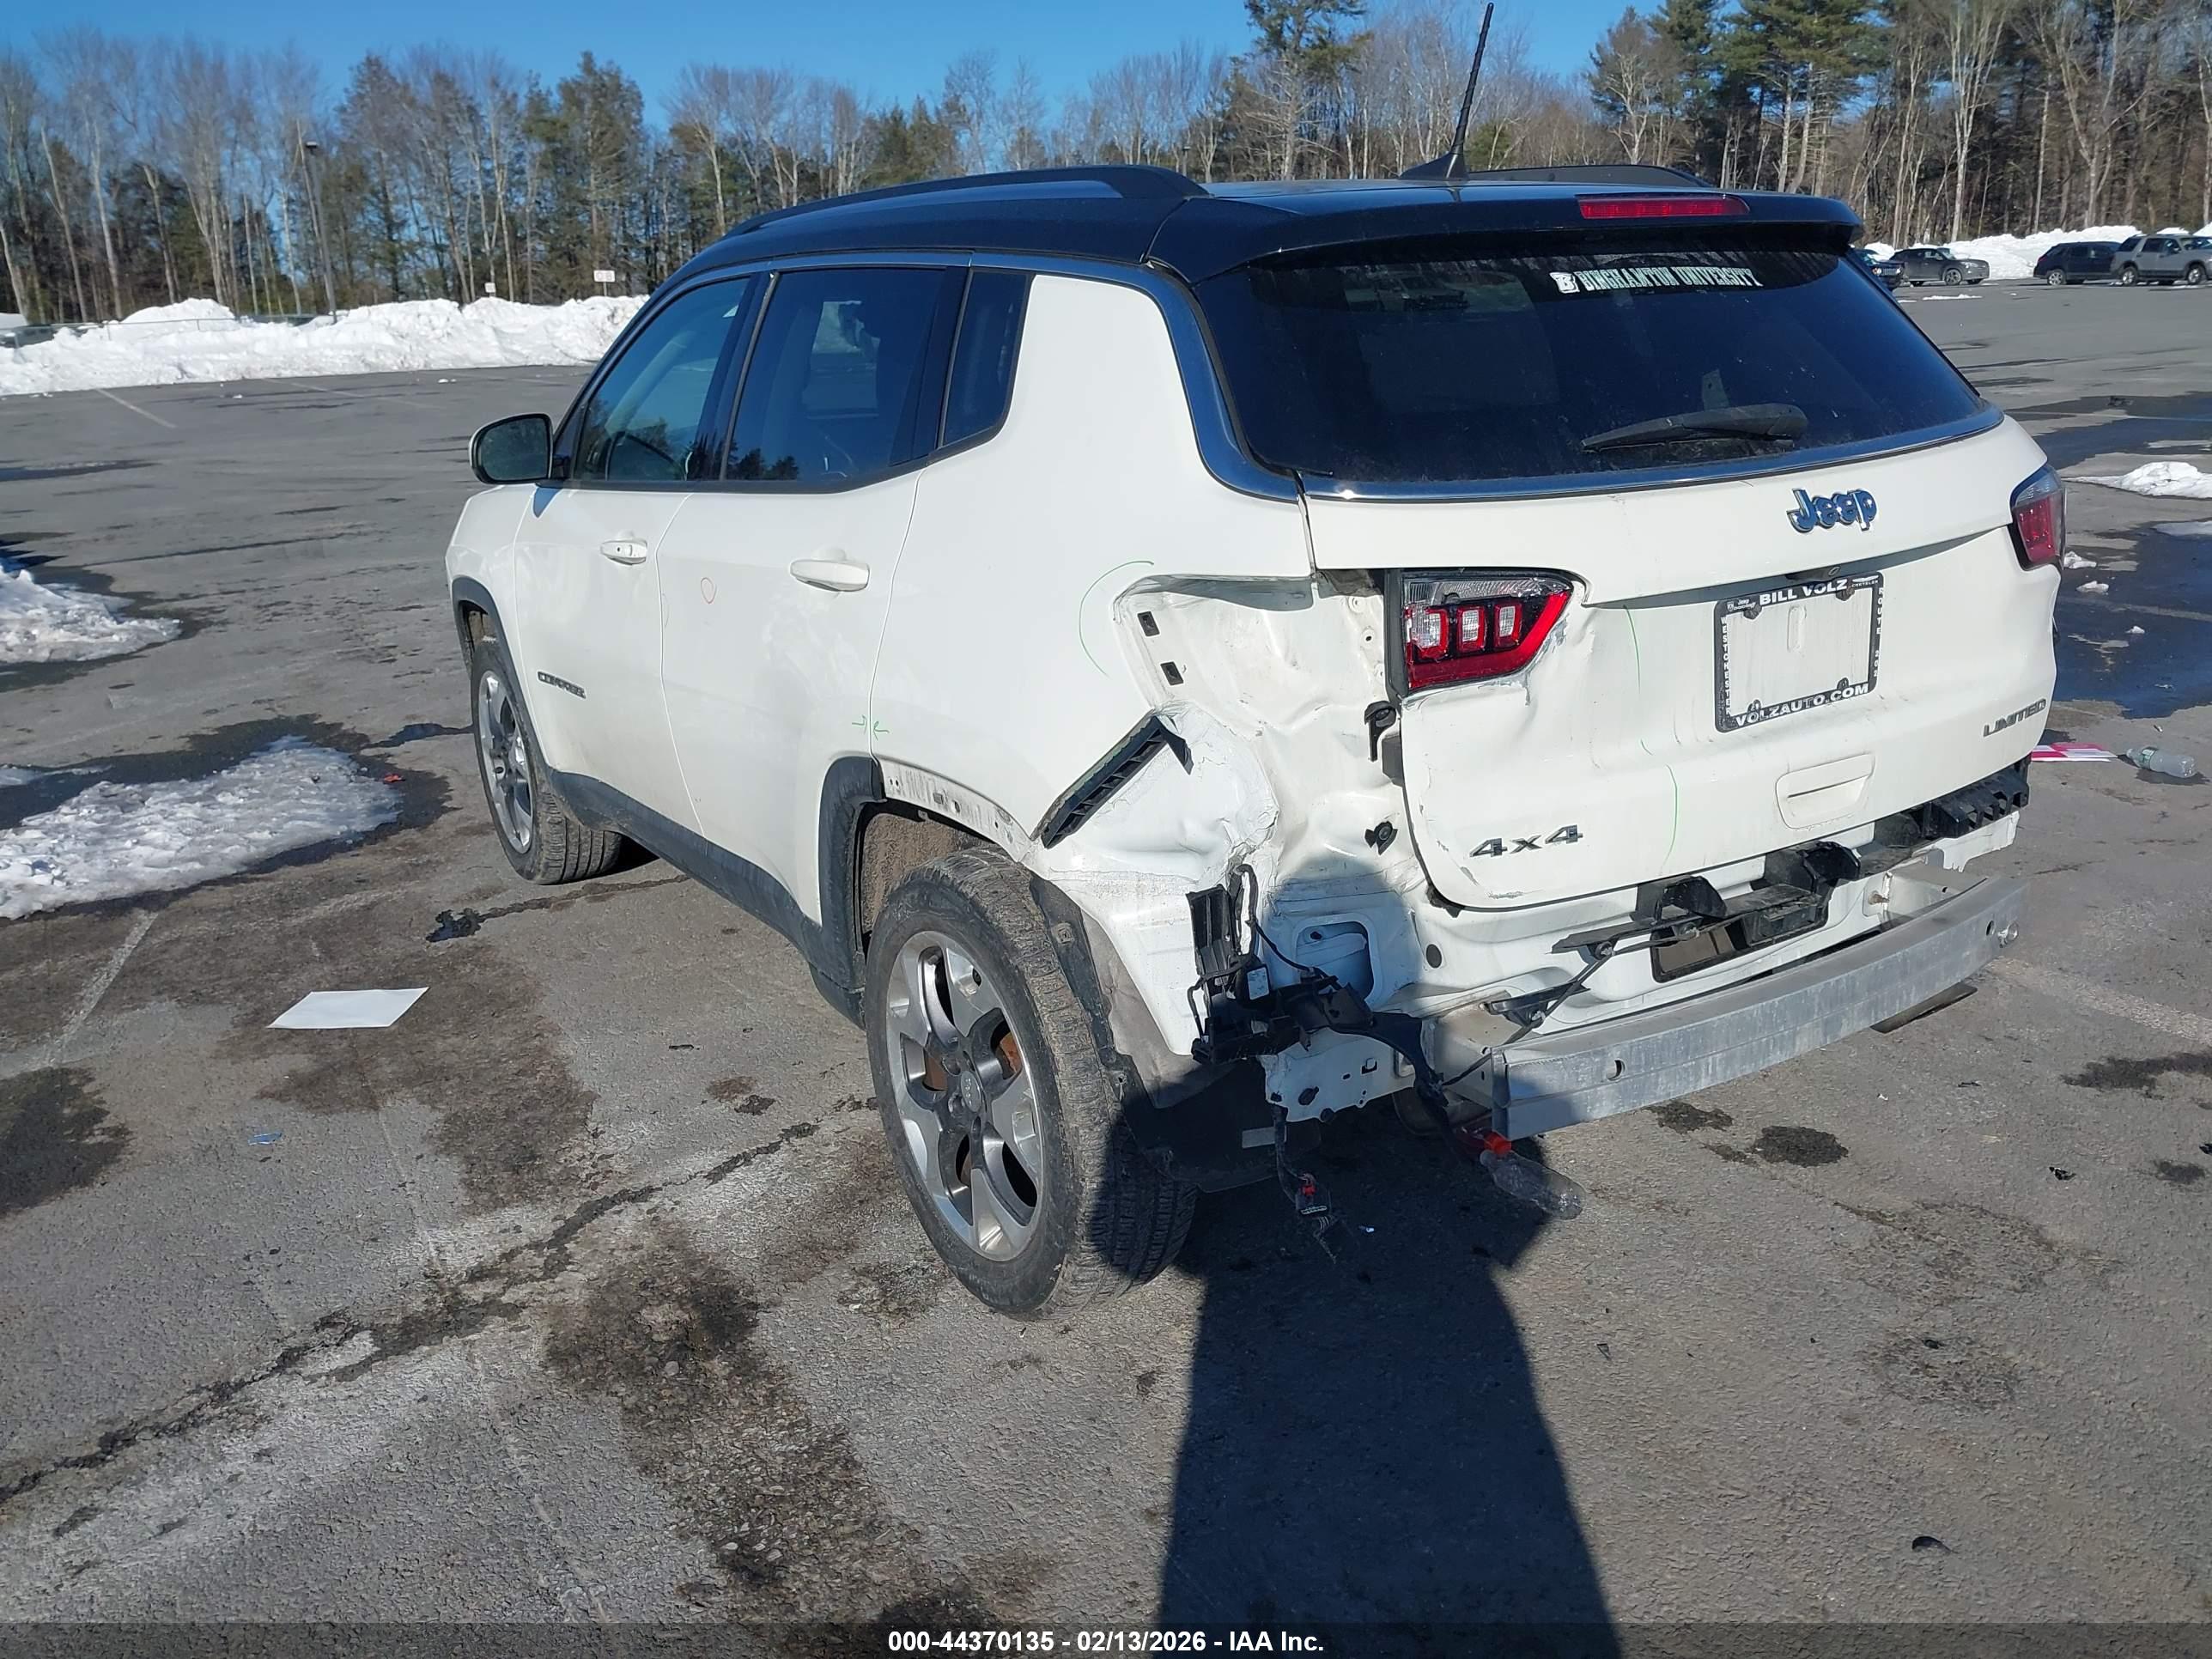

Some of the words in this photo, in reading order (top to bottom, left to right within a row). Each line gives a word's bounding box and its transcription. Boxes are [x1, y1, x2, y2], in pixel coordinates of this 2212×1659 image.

[1573, 267, 1680, 291] BINGHAMTON
[1669, 265, 1764, 286] UNIVERSITY
[1786, 488, 1877, 533] Jeep
[1759, 588, 1797, 605] BILL
[1802, 579, 1848, 597] VOLZ
[1735, 684, 1869, 726] VOLZAUTO.COM
[1983, 698, 2047, 737] LIMITED
